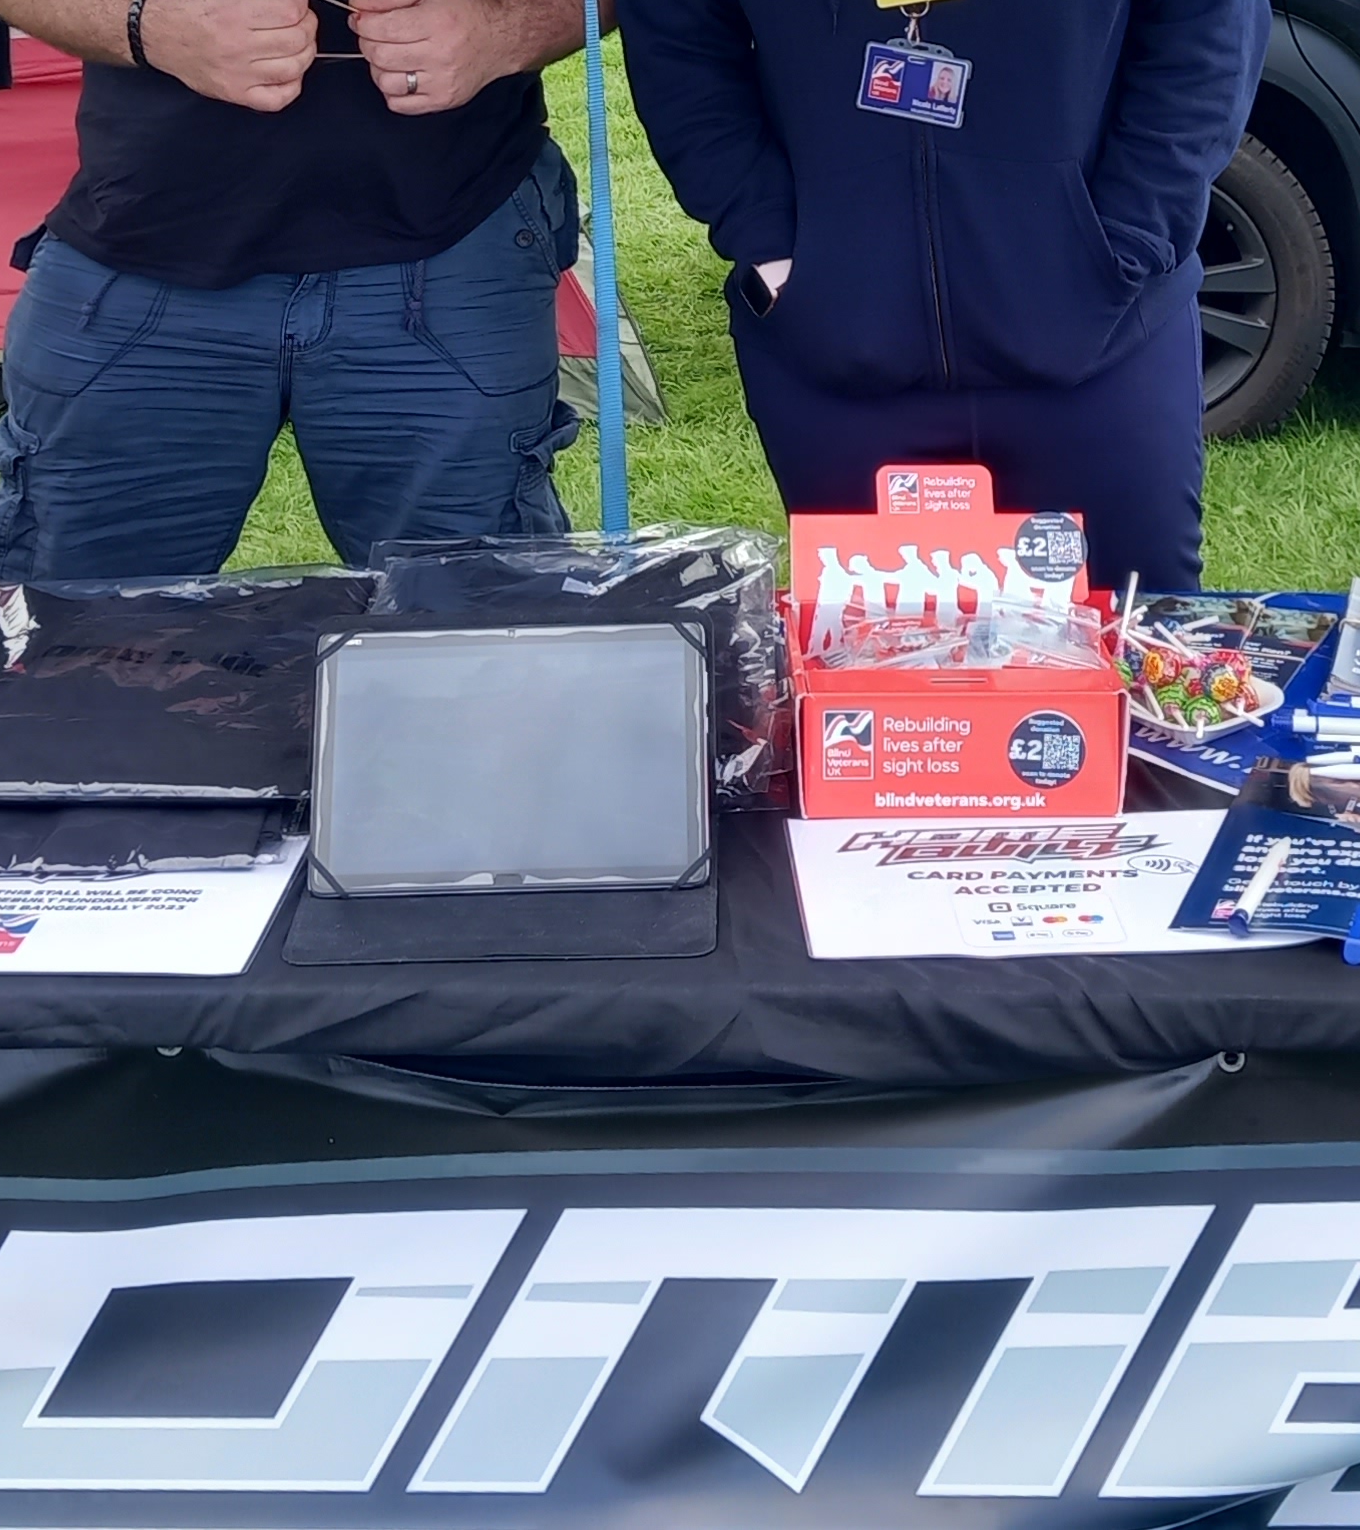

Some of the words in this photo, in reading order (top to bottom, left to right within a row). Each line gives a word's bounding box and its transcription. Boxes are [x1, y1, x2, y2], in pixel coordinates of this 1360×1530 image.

[923, 476, 976, 489] Rebuilding
[923, 488, 946, 499] lives
[947, 488, 972, 500] after
[924, 499, 949, 512] sight
[950, 500, 971, 511] loss
[1016, 536, 1048, 557] £2
[882, 716, 971, 737] Rebuilding
[882, 737, 919, 753] lives
[922, 737, 964, 753] after
[1008, 739, 1042, 761] £2
[826, 747, 852, 758] Blind
[826, 757, 870, 768] Veterans
[882, 757, 924, 776] sight
[927, 757, 960, 774] loss
[826, 767, 842, 777] UK
[874, 791, 1047, 811] blindveterans.org.uk
[1245, 833, 1264, 844] If
[1290, 857, 1332, 867] you
[906, 869, 985, 881] CARD
[989, 867, 1140, 880] PAYMENTS
[953, 883, 1103, 896] ACCEPTED
[1282, 879, 1335, 889] touch
[1337, 880, 1360, 891] by
[151, 888, 203, 896] GOING
[58, 896, 163, 904] FUNDRAISER
[1015, 902, 1077, 913] Square
[971, 918, 1002, 926] VISA
